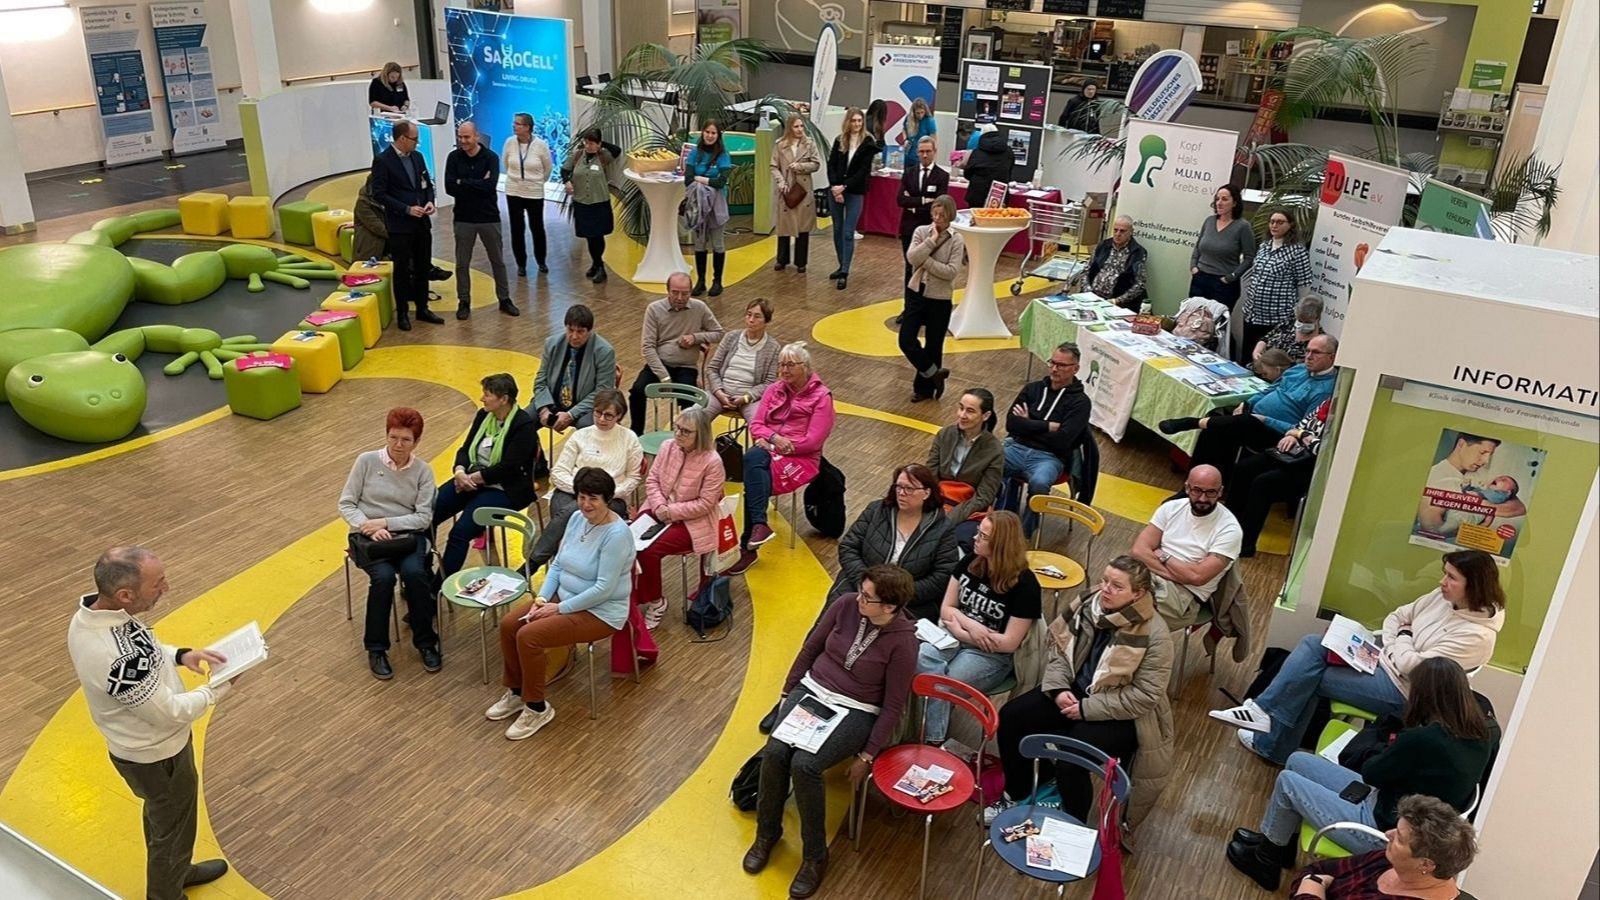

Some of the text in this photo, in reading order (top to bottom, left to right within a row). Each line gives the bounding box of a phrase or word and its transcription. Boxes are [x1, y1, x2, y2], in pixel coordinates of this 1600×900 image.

[1180, 141, 1203, 152] Kopf
[1177, 154, 1198, 165] Hals
[1172, 181, 1199, 194] Krebs
[1327, 172, 1370, 200] TULPE
[1428, 391, 1580, 427] Klinik und Poliklinik für Frauenheilkunde
[1426, 489, 1479, 503] IHRE NERVEN
[1432, 499, 1494, 514] LIEGEN BLANK?
